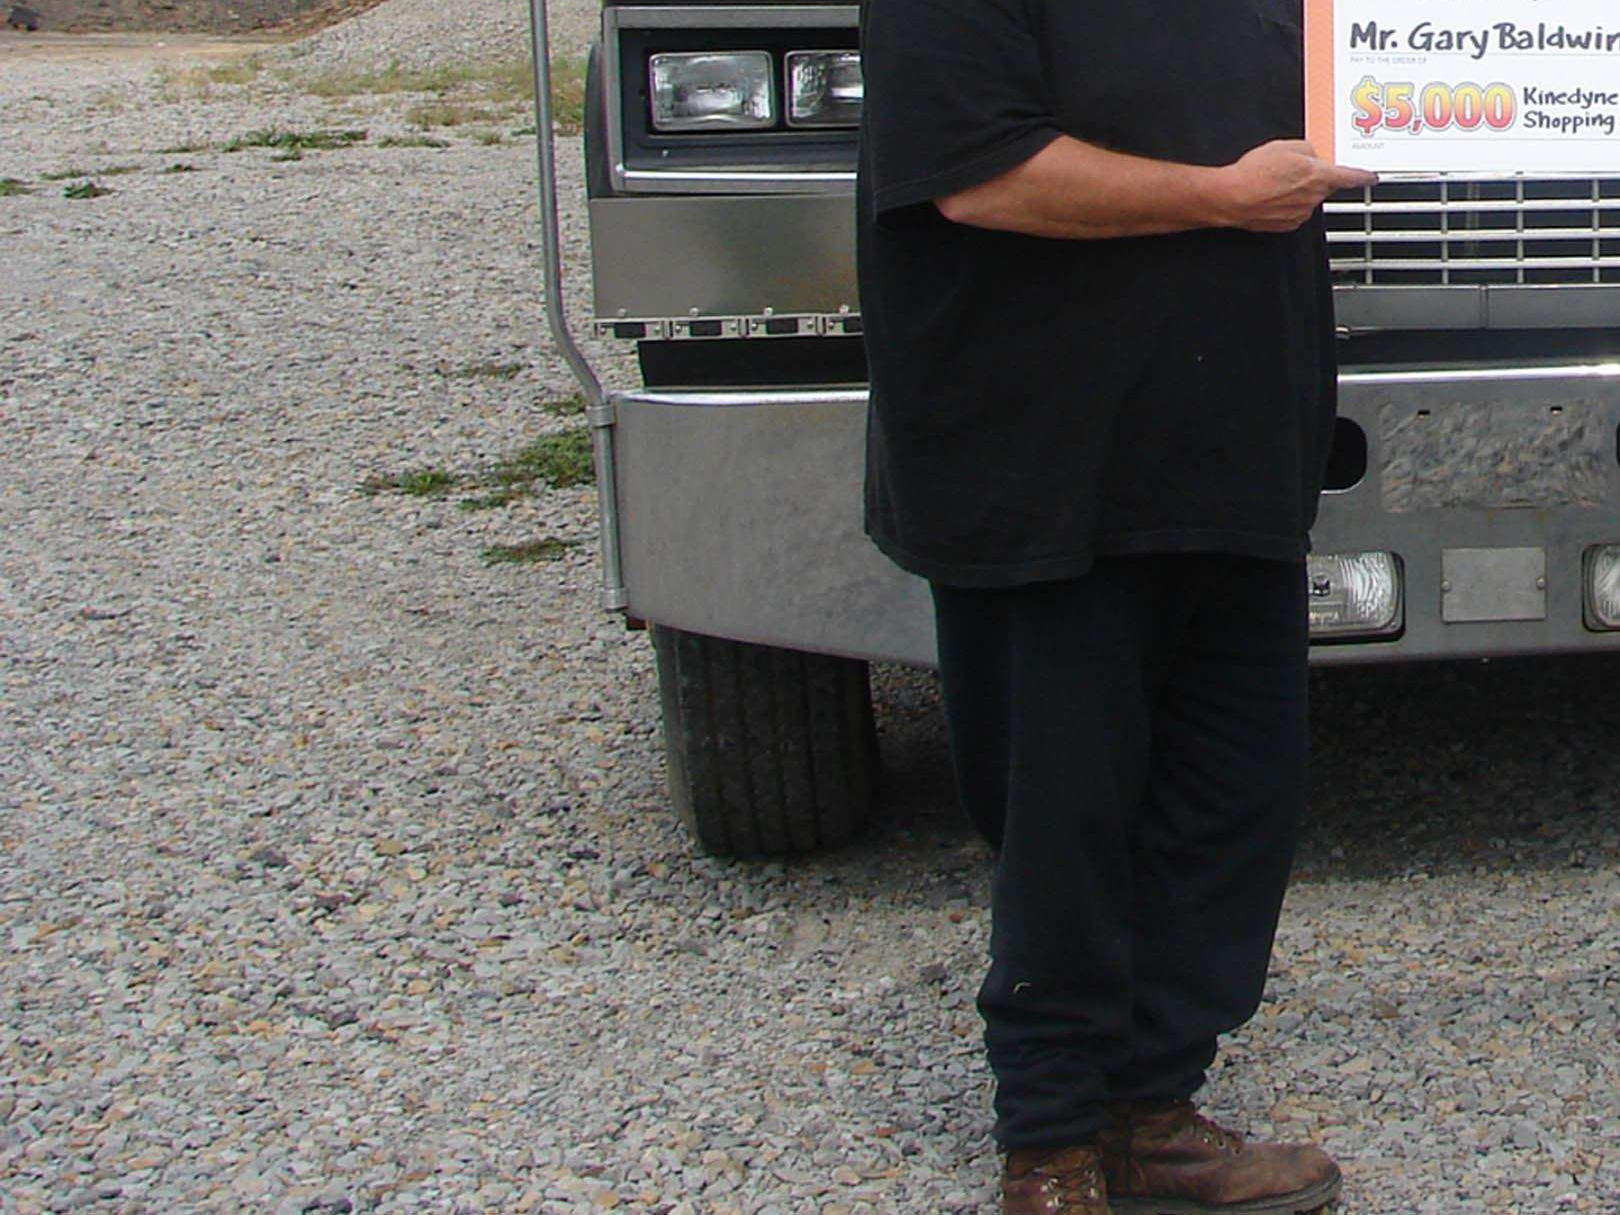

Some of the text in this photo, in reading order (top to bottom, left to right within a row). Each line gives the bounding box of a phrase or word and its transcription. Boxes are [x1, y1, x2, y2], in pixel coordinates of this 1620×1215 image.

[1349, 20, 1398, 51] Mr.
[1407, 21, 1489, 60] Gary
[1350, 75, 1517, 136] $5,000
[1522, 86, 1619, 108] Kinedyne
[1522, 110, 1615, 135] Shopping
